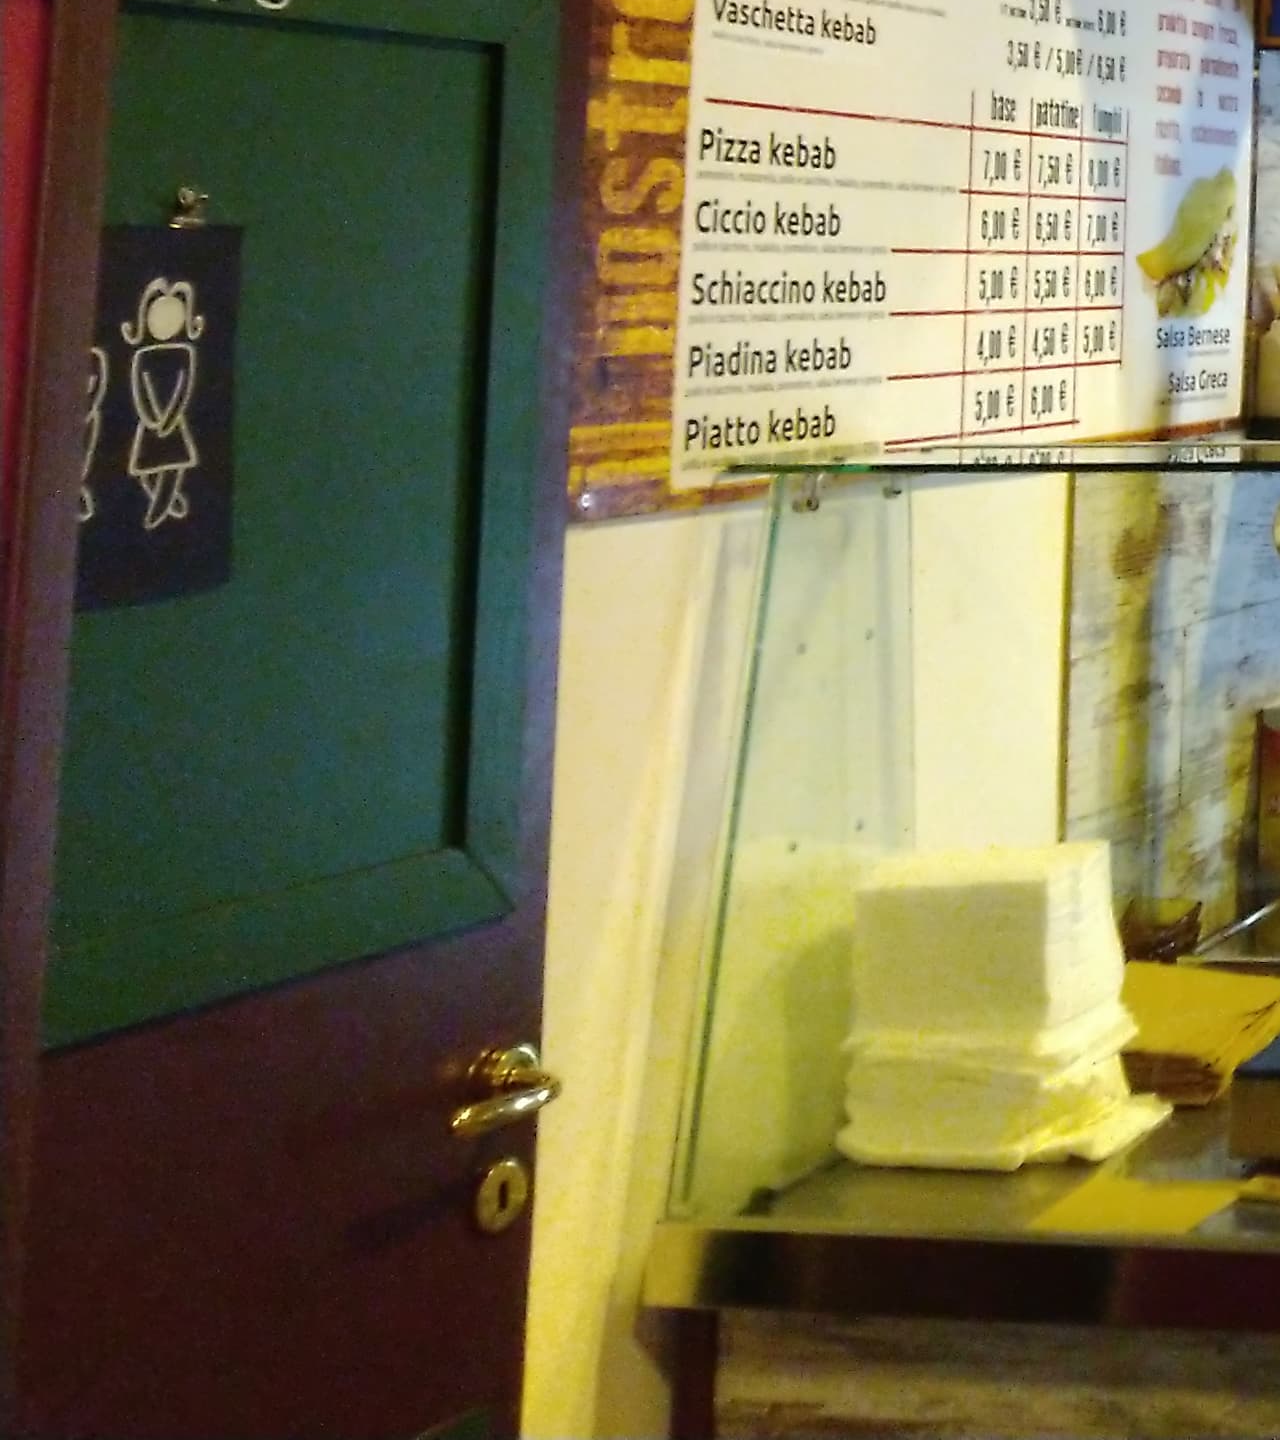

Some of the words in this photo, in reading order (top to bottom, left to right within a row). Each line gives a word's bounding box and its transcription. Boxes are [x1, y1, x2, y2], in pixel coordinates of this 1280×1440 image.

[819, 8, 877, 45] kebab
[990, 90, 1017, 124] base
[1035, 99, 1081, 131] patatine
[699, 127, 762, 165] Pizza
[767, 131, 837, 170] kebab
[695, 198, 767, 235] Ciccio
[773, 200, 842, 237] kebab
[690, 269, 816, 306] Schiaccino
[822, 269, 887, 304] kebab
[1156, 325, 1186, 349] Salsa
[1187, 324, 1231, 348] Bernese
[688, 340, 778, 378] Piadina
[784, 336, 852, 374] kebab
[1168, 370, 1197, 394] Salsa
[1198, 368, 1229, 393] Greca
[684, 414, 761, 452] Piatto
[767, 404, 837, 444] kebab
